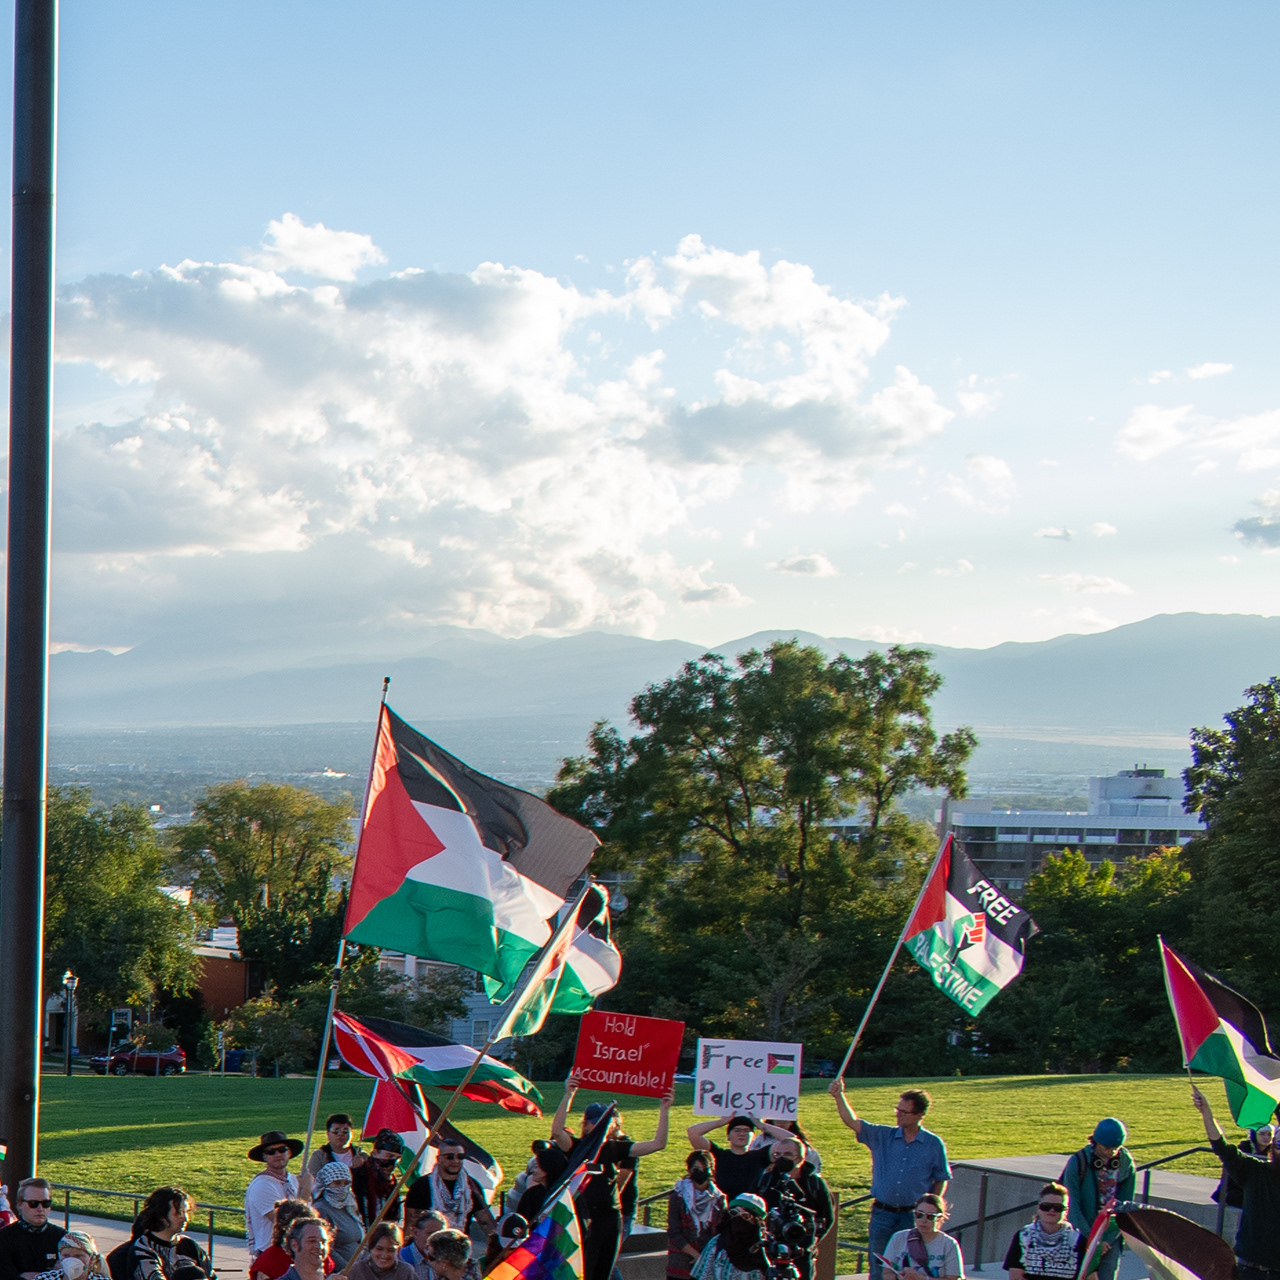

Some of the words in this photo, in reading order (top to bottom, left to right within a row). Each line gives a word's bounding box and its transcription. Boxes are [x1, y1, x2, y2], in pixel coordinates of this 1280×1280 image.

[966, 880, 1021, 925] FREE
[603, 1016, 636, 1037] Hold
[702, 1044, 764, 1070] Free
[700, 1080, 797, 1114] Palestine
